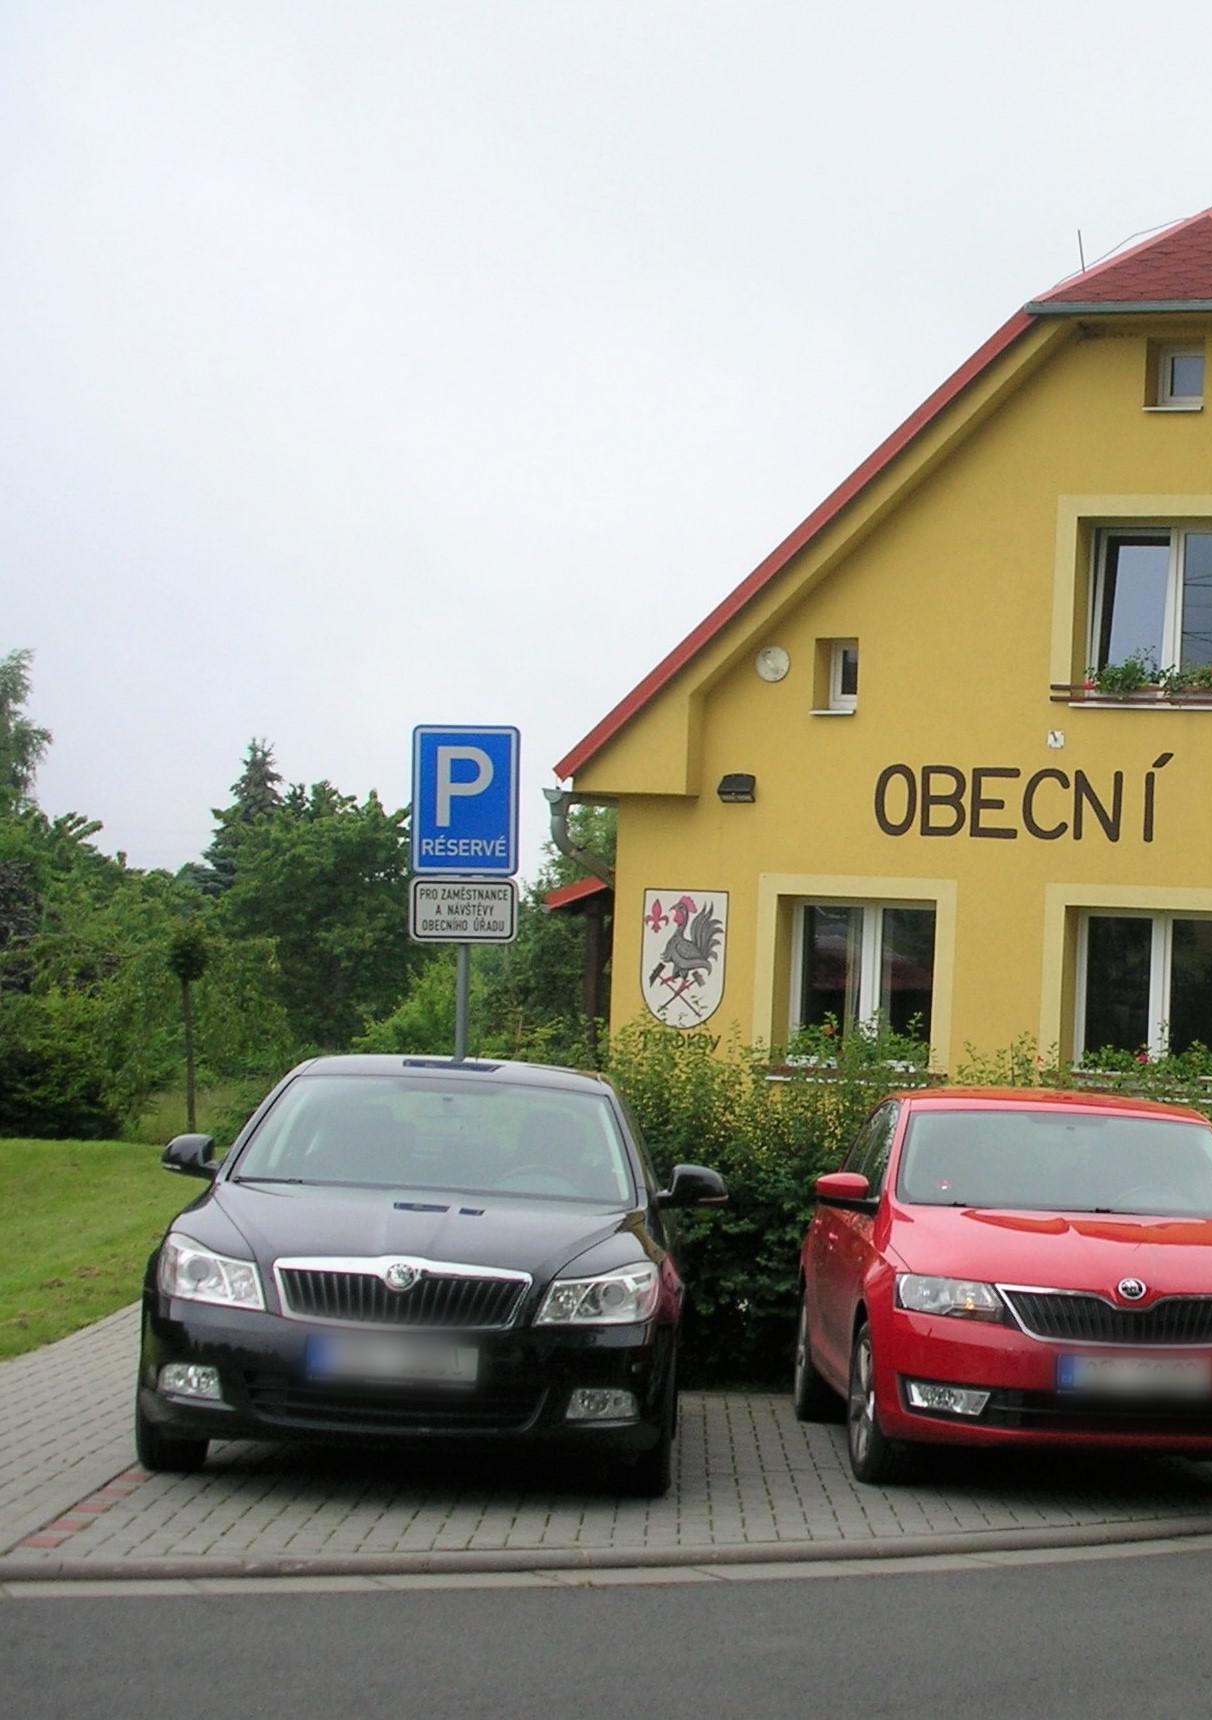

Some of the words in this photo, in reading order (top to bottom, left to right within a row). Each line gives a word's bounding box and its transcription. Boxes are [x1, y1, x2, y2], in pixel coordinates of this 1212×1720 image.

[435, 745, 494, 828] P
[873, 752, 1175, 843] OBECNÍ
[421, 835, 508, 857] RÉSERVÉ
[419, 887, 439, 901] PRO
[435, 904, 442, 915] A
[421, 917, 469, 932] OBECNÍHO
[473, 917, 505, 932] ÚŘADU
